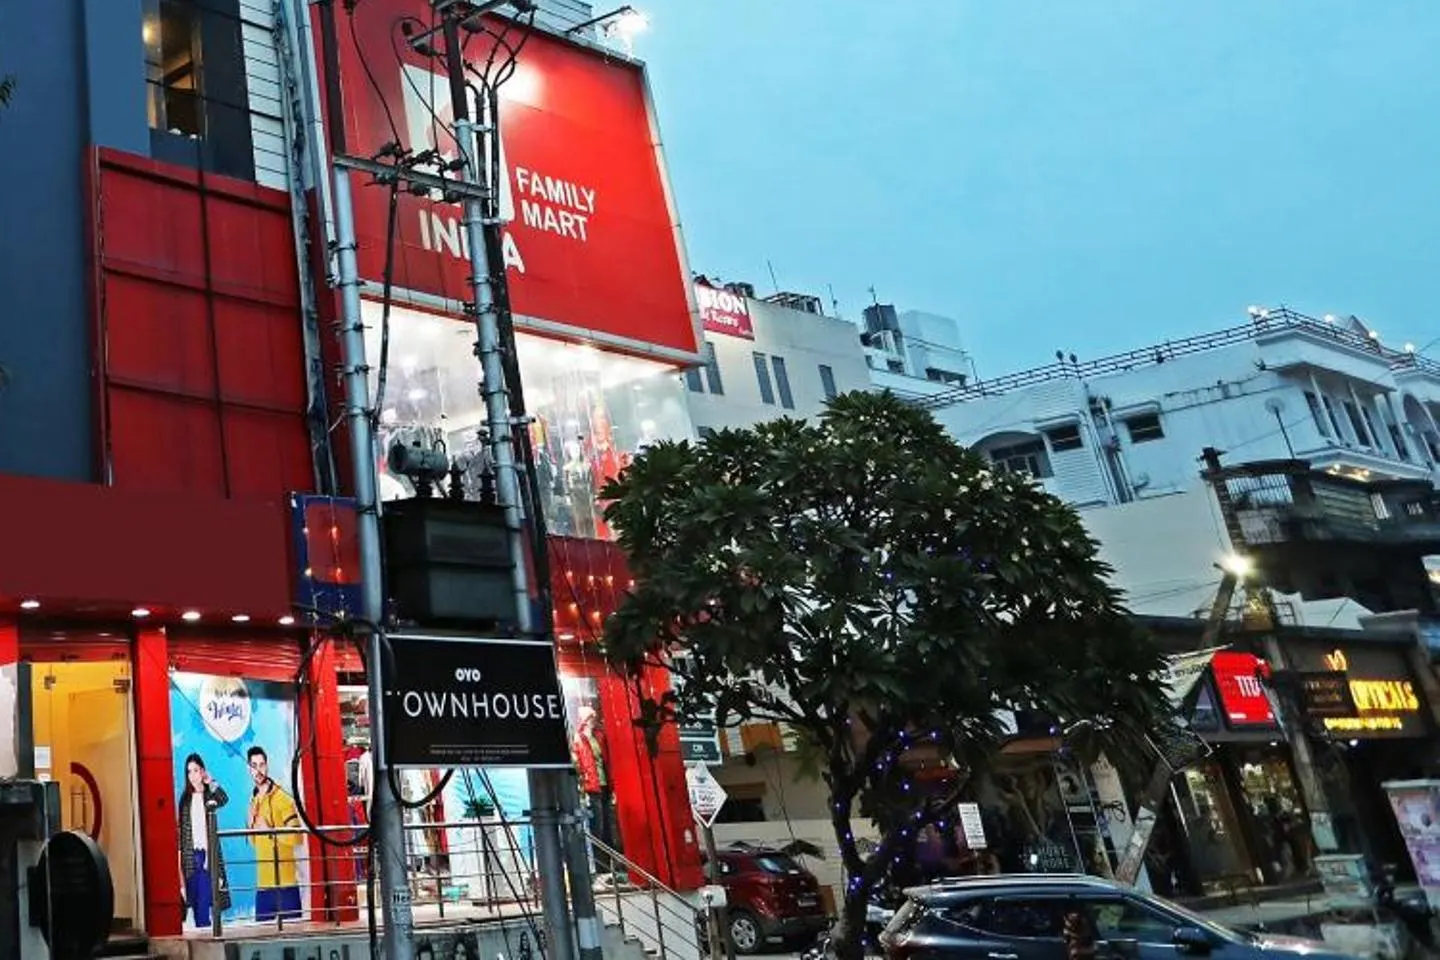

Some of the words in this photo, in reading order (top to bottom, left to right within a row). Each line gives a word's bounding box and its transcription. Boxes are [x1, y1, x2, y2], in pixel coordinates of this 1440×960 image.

[515, 165, 596, 215] FAMILY
[418, 209, 526, 275] INA
[521, 199, 588, 243] MART
[455, 667, 481, 683] OYO
[385, 690, 560, 719] OWNHOUSE
